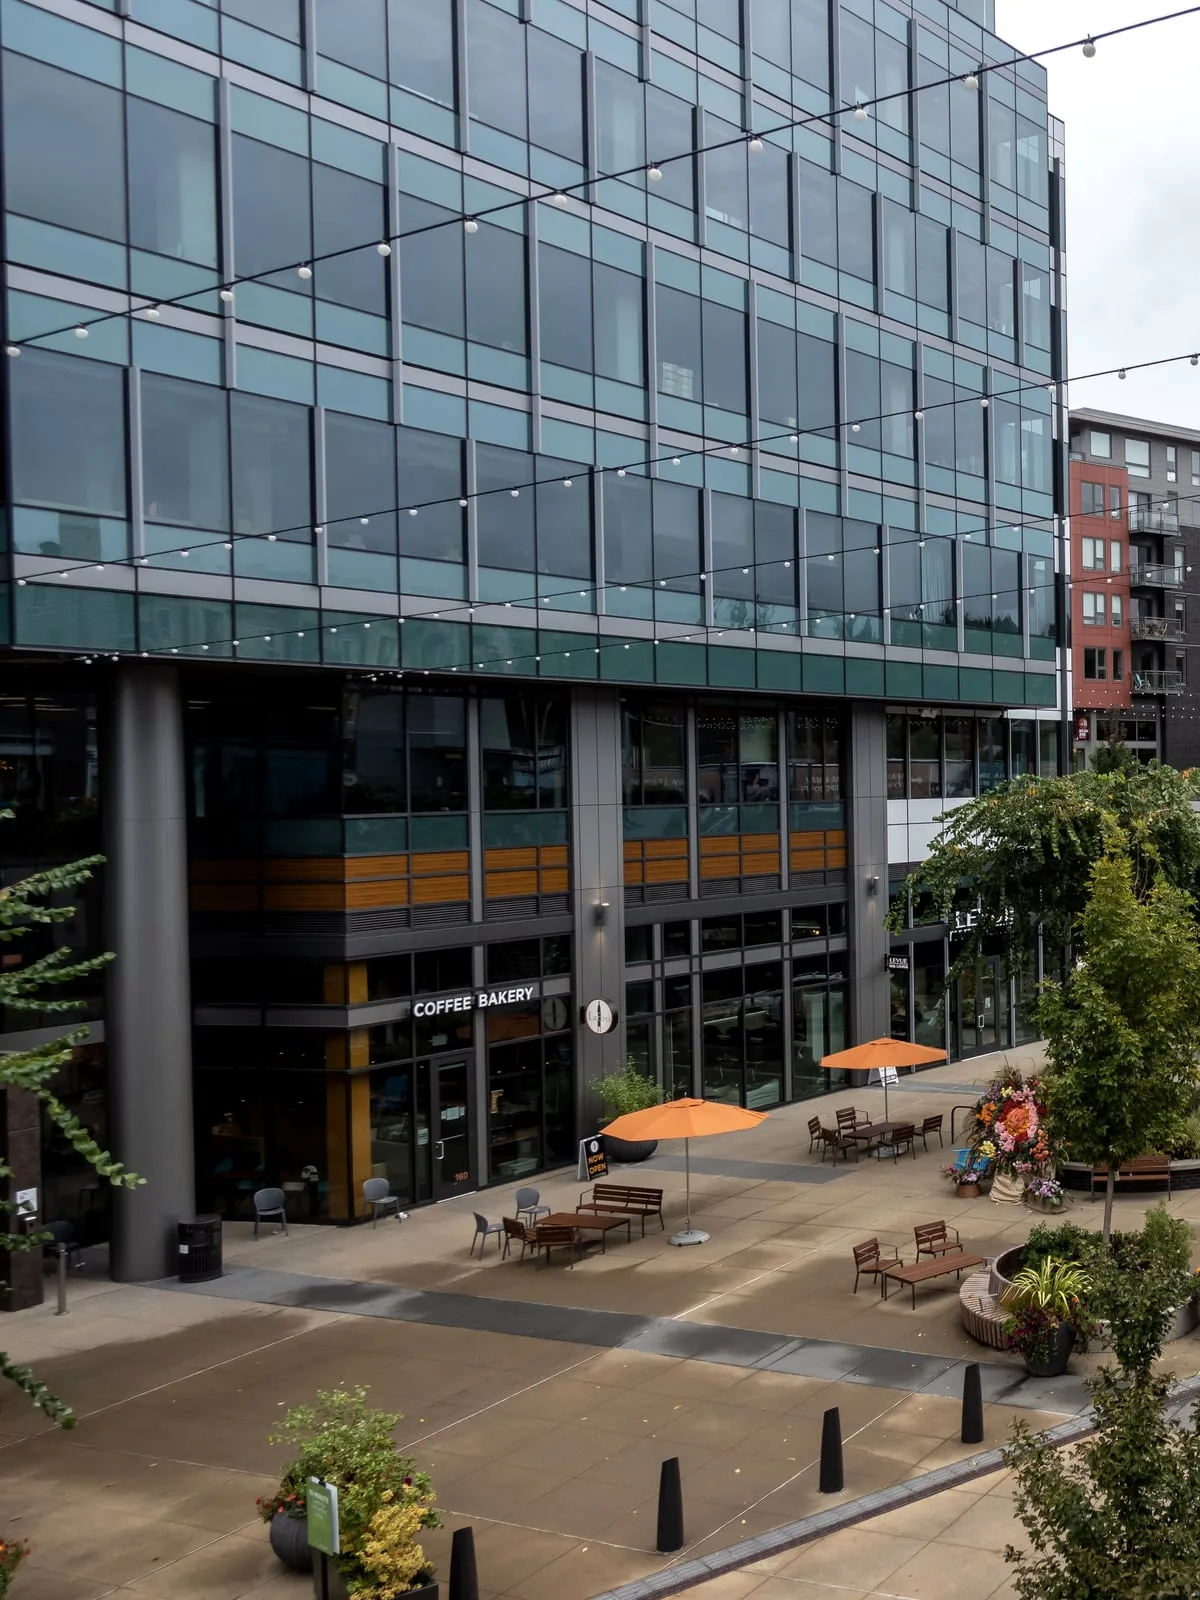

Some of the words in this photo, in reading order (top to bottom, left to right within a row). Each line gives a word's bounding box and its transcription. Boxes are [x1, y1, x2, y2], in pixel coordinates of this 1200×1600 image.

[413, 996, 472, 1018] COFFEE
[477, 986, 534, 1008] BAKERY
[588, 1152, 604, 1164] NOW
[589, 1162, 606, 1175] OPEN
[455, 1171, 469, 1181] 160
